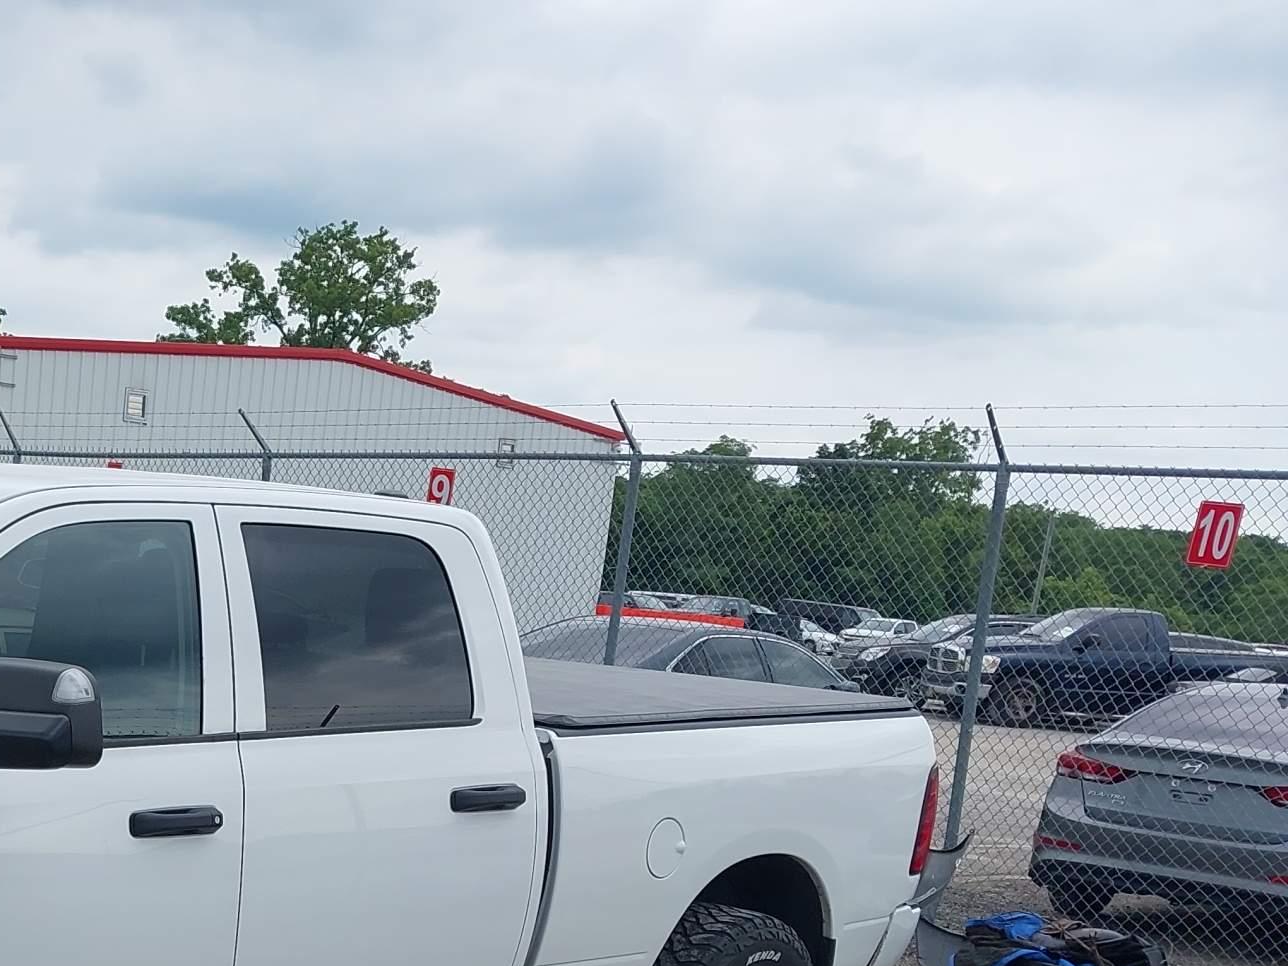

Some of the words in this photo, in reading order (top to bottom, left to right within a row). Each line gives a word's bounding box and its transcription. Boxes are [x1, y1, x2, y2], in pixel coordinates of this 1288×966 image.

[432, 474, 450, 505] 9
[1198, 509, 1235, 560] 10
[745, 950, 782, 966] KENDA
